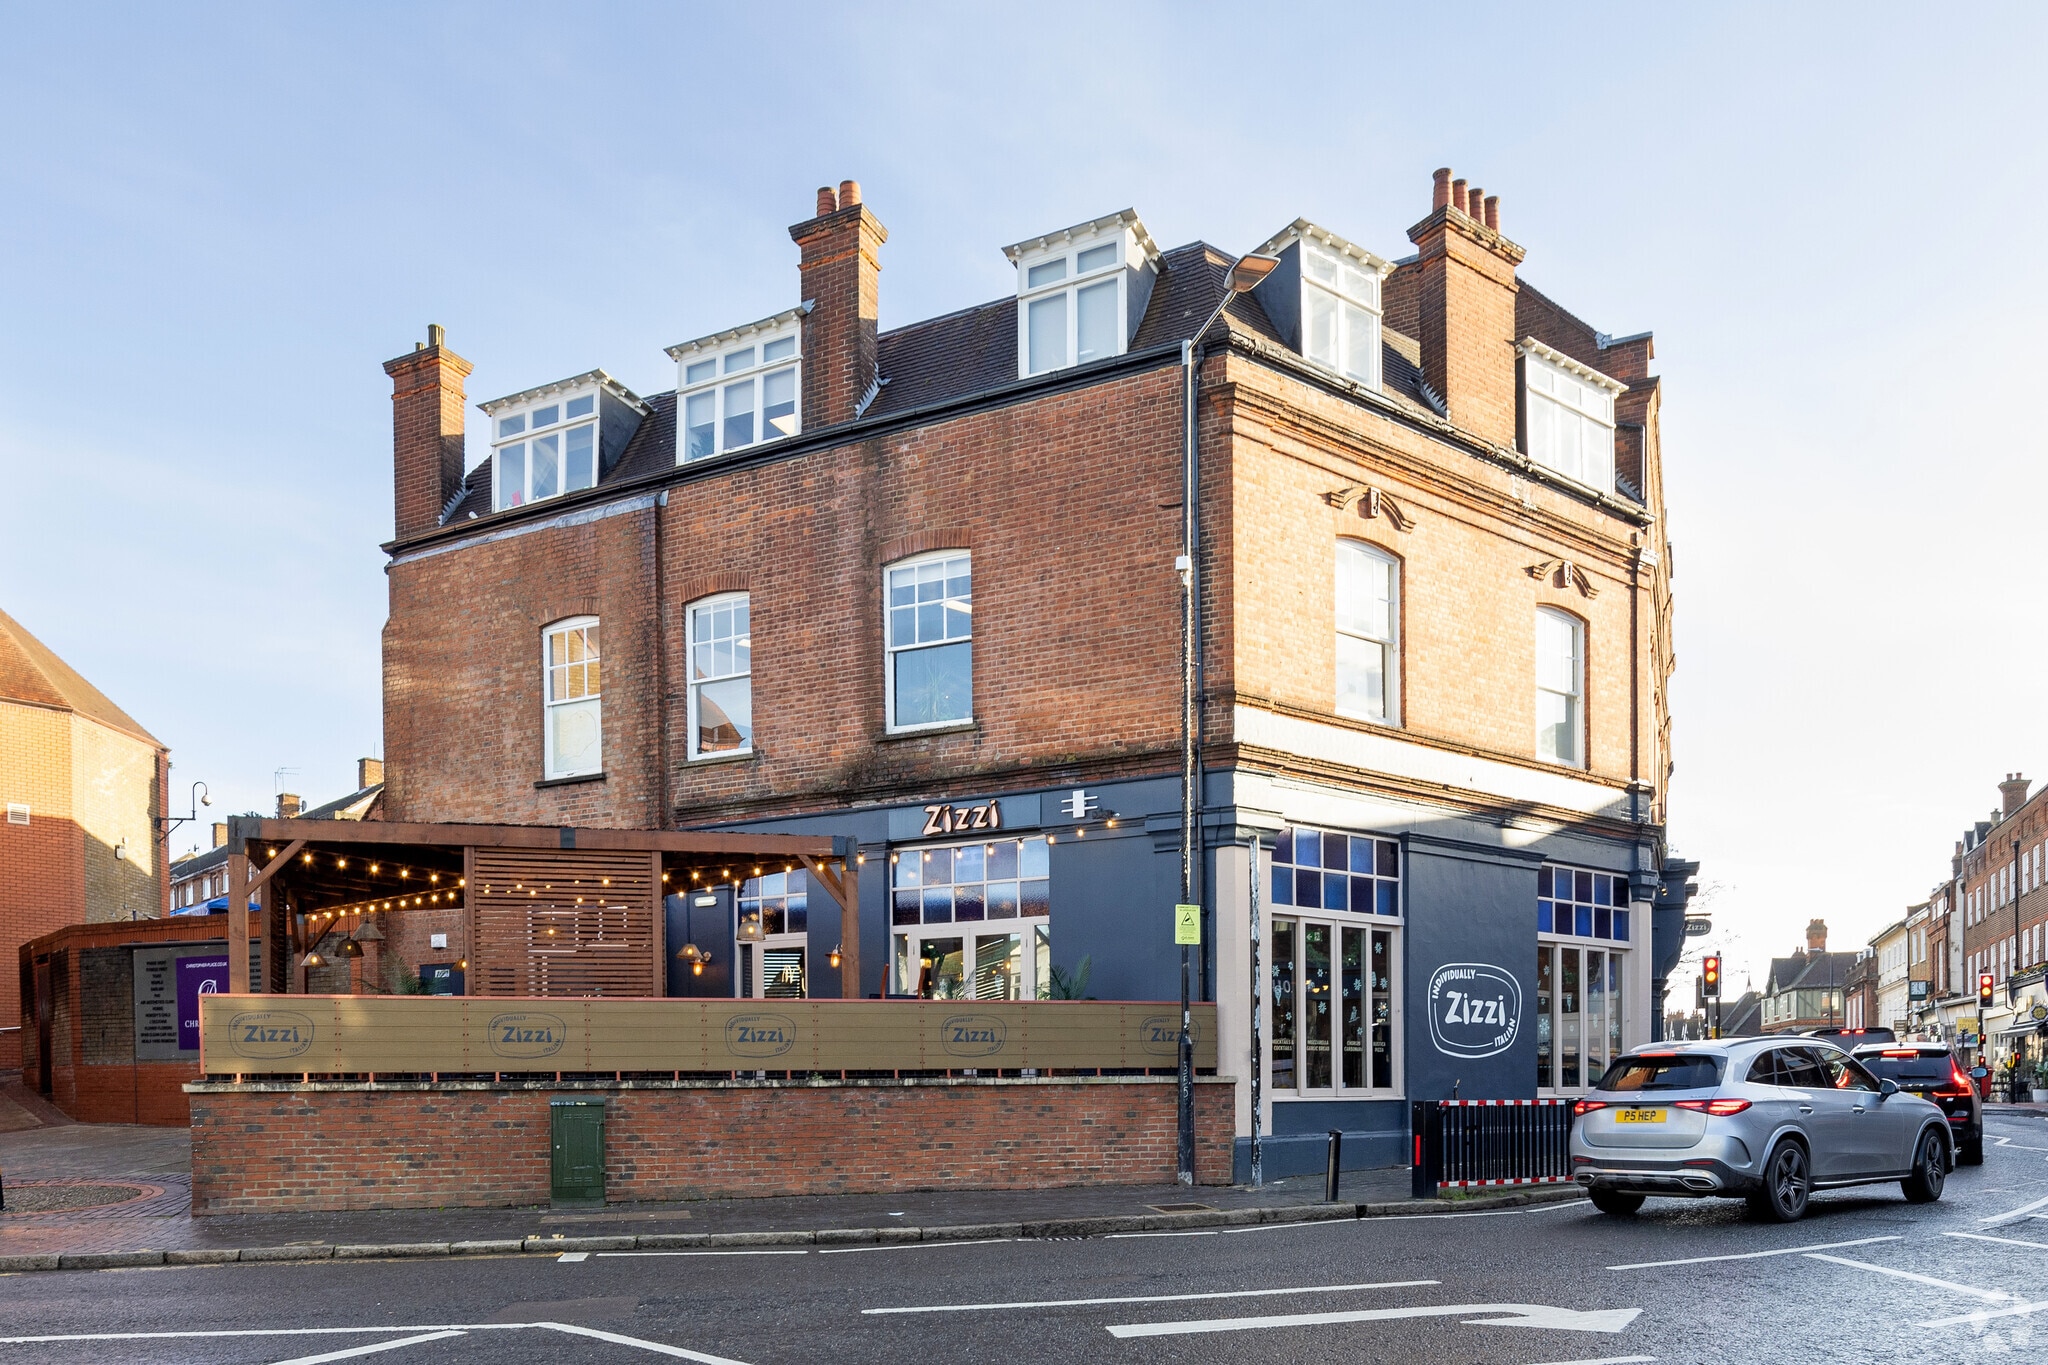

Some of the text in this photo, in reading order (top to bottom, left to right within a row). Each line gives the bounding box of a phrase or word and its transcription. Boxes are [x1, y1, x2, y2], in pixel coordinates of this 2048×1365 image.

[922, 799, 1001, 836] Zizzi
[1686, 923, 1707, 931] Zizzi
[1431, 968, 1477, 1000] INDIVIDUALLY
[1444, 990, 1506, 1027] Zizzi
[244, 1025, 299, 1042] Zizzi
[501, 1026, 553, 1043] Zizzi
[737, 1026, 784, 1043] Zizzi
[952, 1027, 995, 1043] Zizzi
[1494, 1017, 1517, 1047] ITALIAN
[1624, 1110, 1657, 1121] P5 HEP
